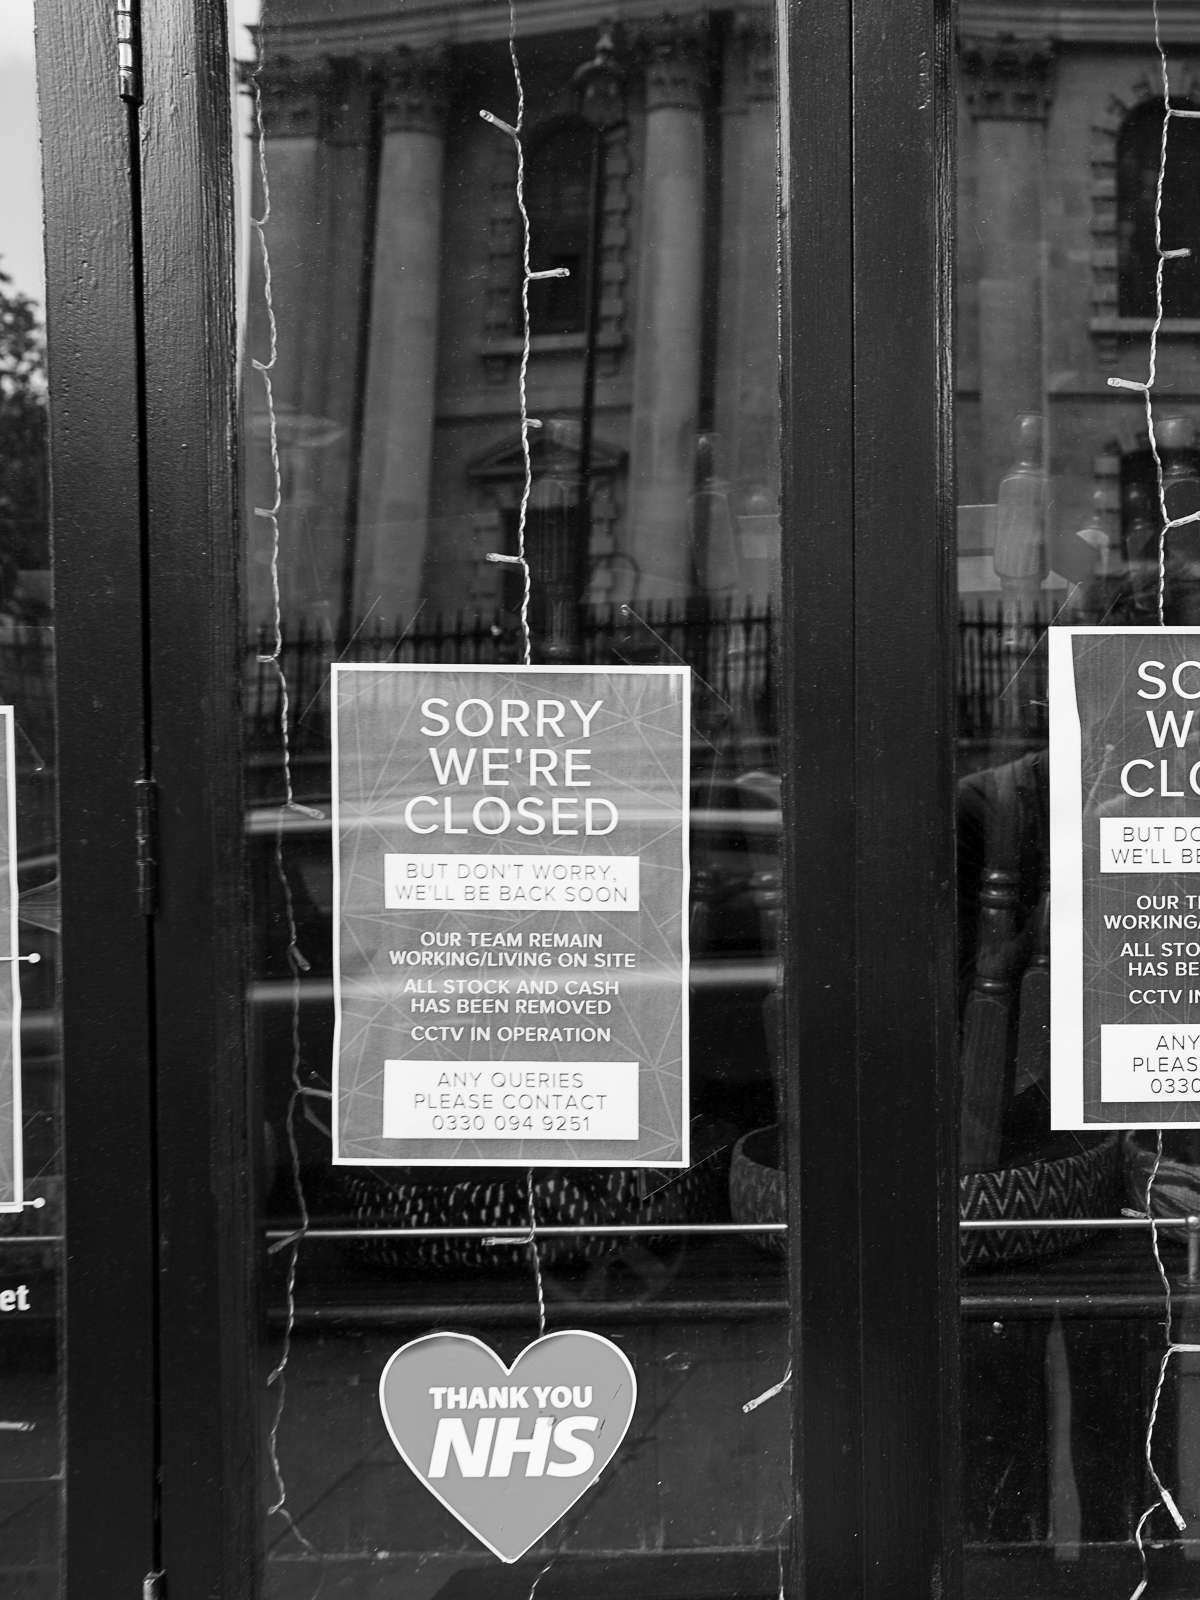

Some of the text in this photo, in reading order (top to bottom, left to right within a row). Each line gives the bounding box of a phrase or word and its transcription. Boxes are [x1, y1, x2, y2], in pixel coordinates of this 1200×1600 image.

[420, 697, 603, 738] SORRY
[429, 747, 592, 787] WE'RE
[404, 795, 619, 836] CLOSED
[1123, 826, 1165, 843] BUT
[1112, 848, 1171, 864] WE'LL
[407, 863, 617, 882] BUT DON'T WORRY,
[396, 885, 627, 903] WE'LL BE BACK SOON
[1136, 895, 1178, 911] OUR
[420, 931, 602, 948] OUR TEAM REMAIN
[1120, 942, 1154, 958] ALL
[389, 951, 636, 968] WORKING/LIVING ON SITE
[1128, 961, 1169, 977] HAS
[404, 979, 619, 996] ALL STOCK AND CASH
[1129, 989, 1182, 1005] CCTV
[410, 998, 611, 1015] HAS BEEN REMOVED
[410, 1026, 611, 1043] CCTV IN OPERATION
[1156, 1034, 1200, 1050] ANY
[438, 1072, 584, 1089] ANY QUERIES
[414, 1093, 607, 1111] PLEASE CONTACT
[432, 1115, 590, 1132] 0330 094 9251
[429, 1385, 593, 1409] THANK YOU
[427, 1415, 599, 1478] NHS
